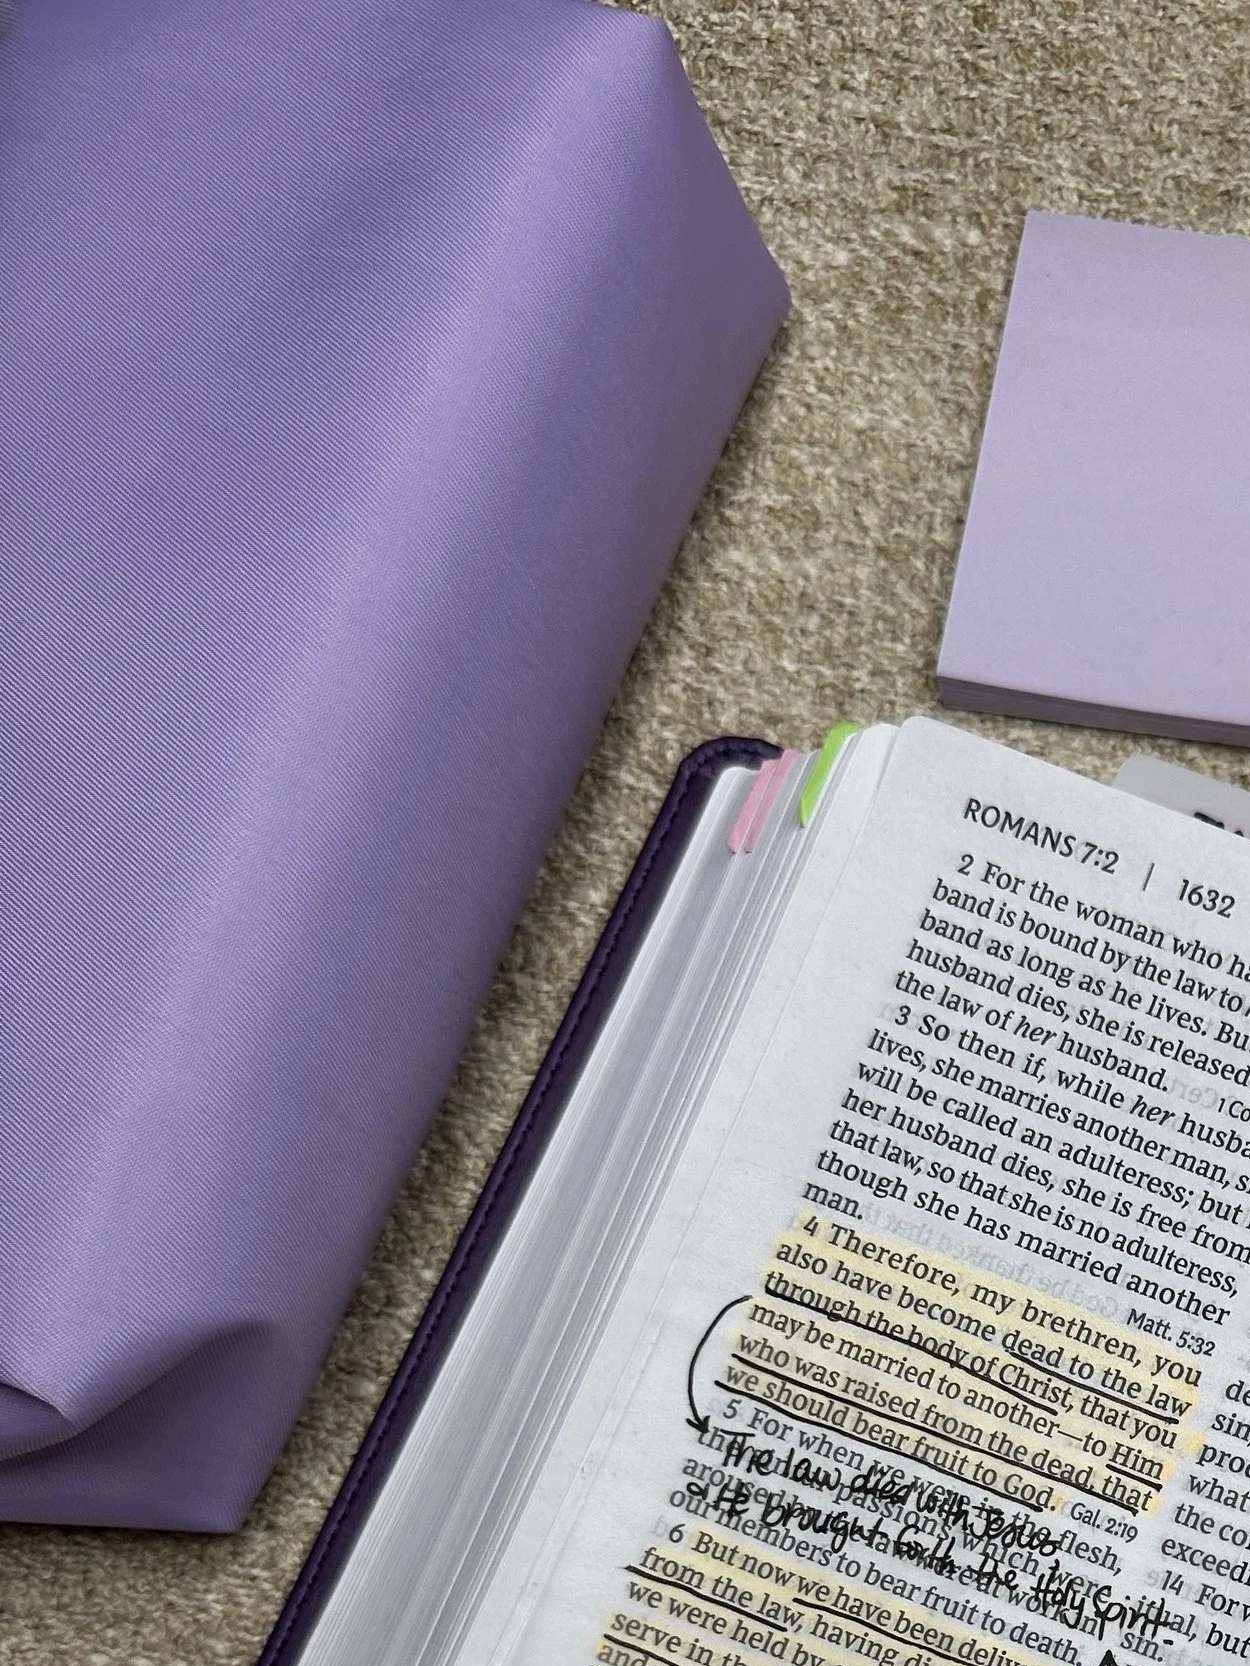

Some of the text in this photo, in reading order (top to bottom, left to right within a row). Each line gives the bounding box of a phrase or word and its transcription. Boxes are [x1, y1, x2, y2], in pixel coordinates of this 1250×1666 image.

[964, 798, 1235, 918] ROMANS 7:2 1632
[957, 854, 974, 876] 2
[980, 861, 1025, 895] For
[1029, 881, 1069, 912] the
[1077, 900, 1165, 949] woman
[1173, 937, 1223, 969] who
[1218, 1098, 1226, 1113] 1
[1126, 1308, 1215, 1357] Matt. 5:32
[1070, 1502, 1138, 1543] Gal. 2:19
